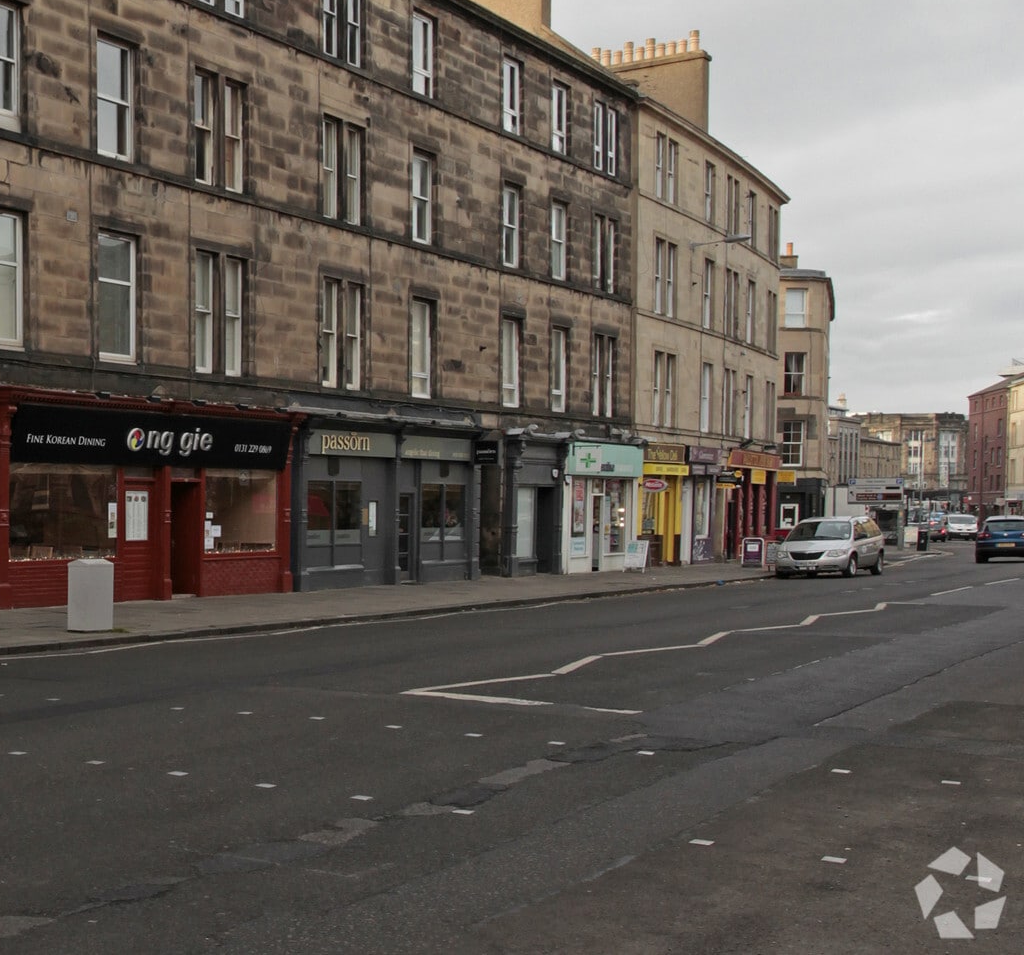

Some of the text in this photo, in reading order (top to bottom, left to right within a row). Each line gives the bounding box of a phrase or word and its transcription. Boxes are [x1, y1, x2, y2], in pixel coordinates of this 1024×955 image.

[26, 433, 106, 447] FINE KOREAN DINING
[179, 428, 214, 456] gie
[234, 443, 248, 453] 0131
[248, 444, 259, 453] 229
